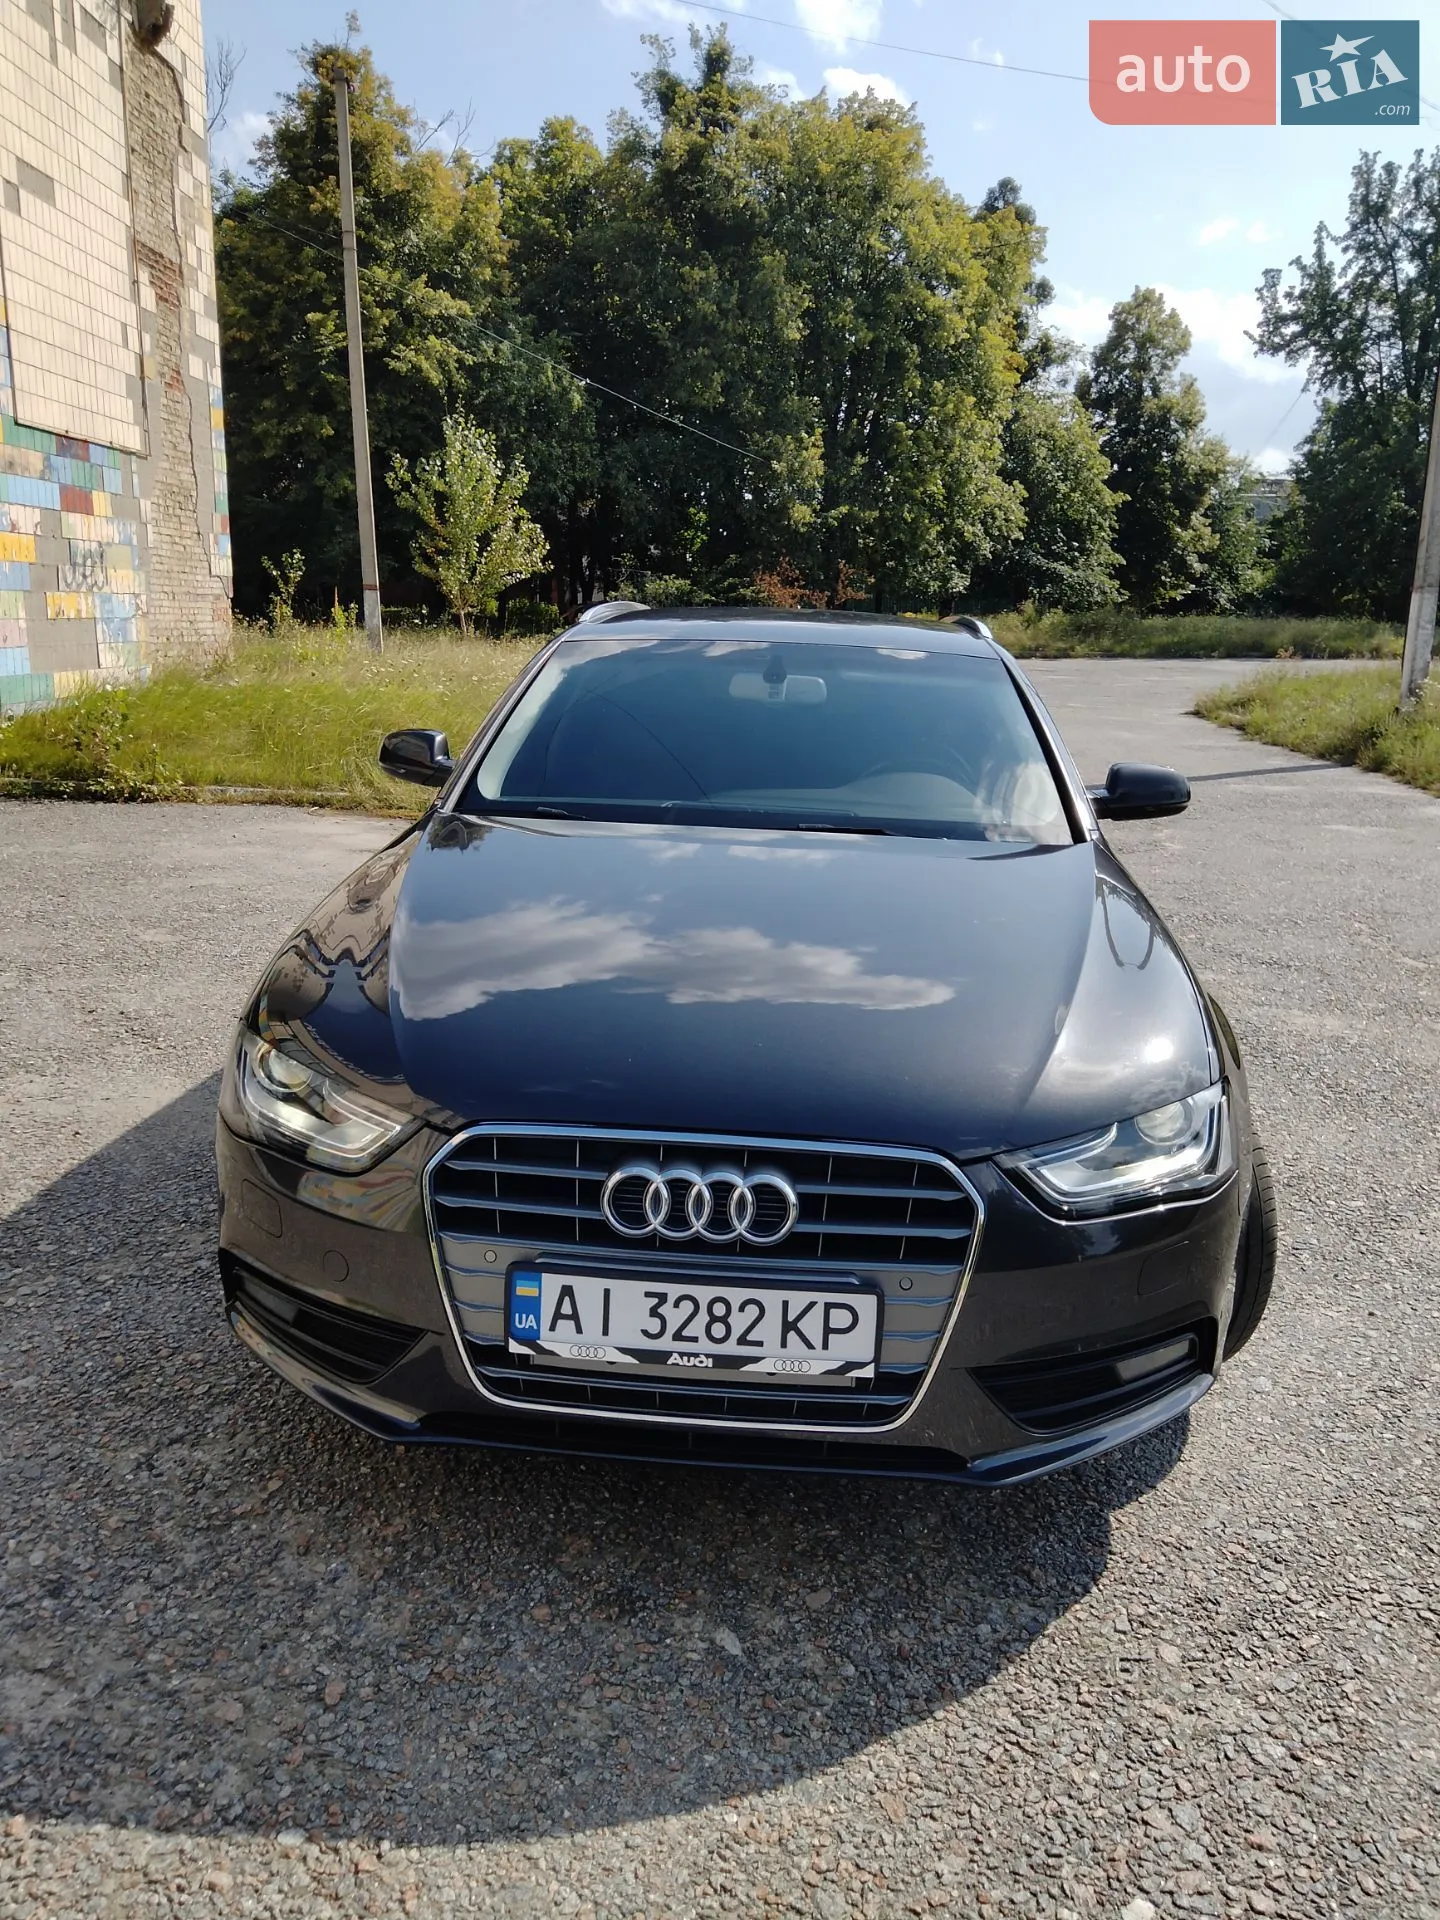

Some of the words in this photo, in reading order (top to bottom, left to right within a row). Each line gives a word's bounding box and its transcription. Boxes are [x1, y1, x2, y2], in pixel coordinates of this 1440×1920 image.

[514, 1312, 538, 1329] UA
[548, 1284, 610, 1337] AI
[640, 1291, 766, 1347] 3282
[780, 1299, 860, 1351] KP
[666, 1351, 714, 1369] Audi
